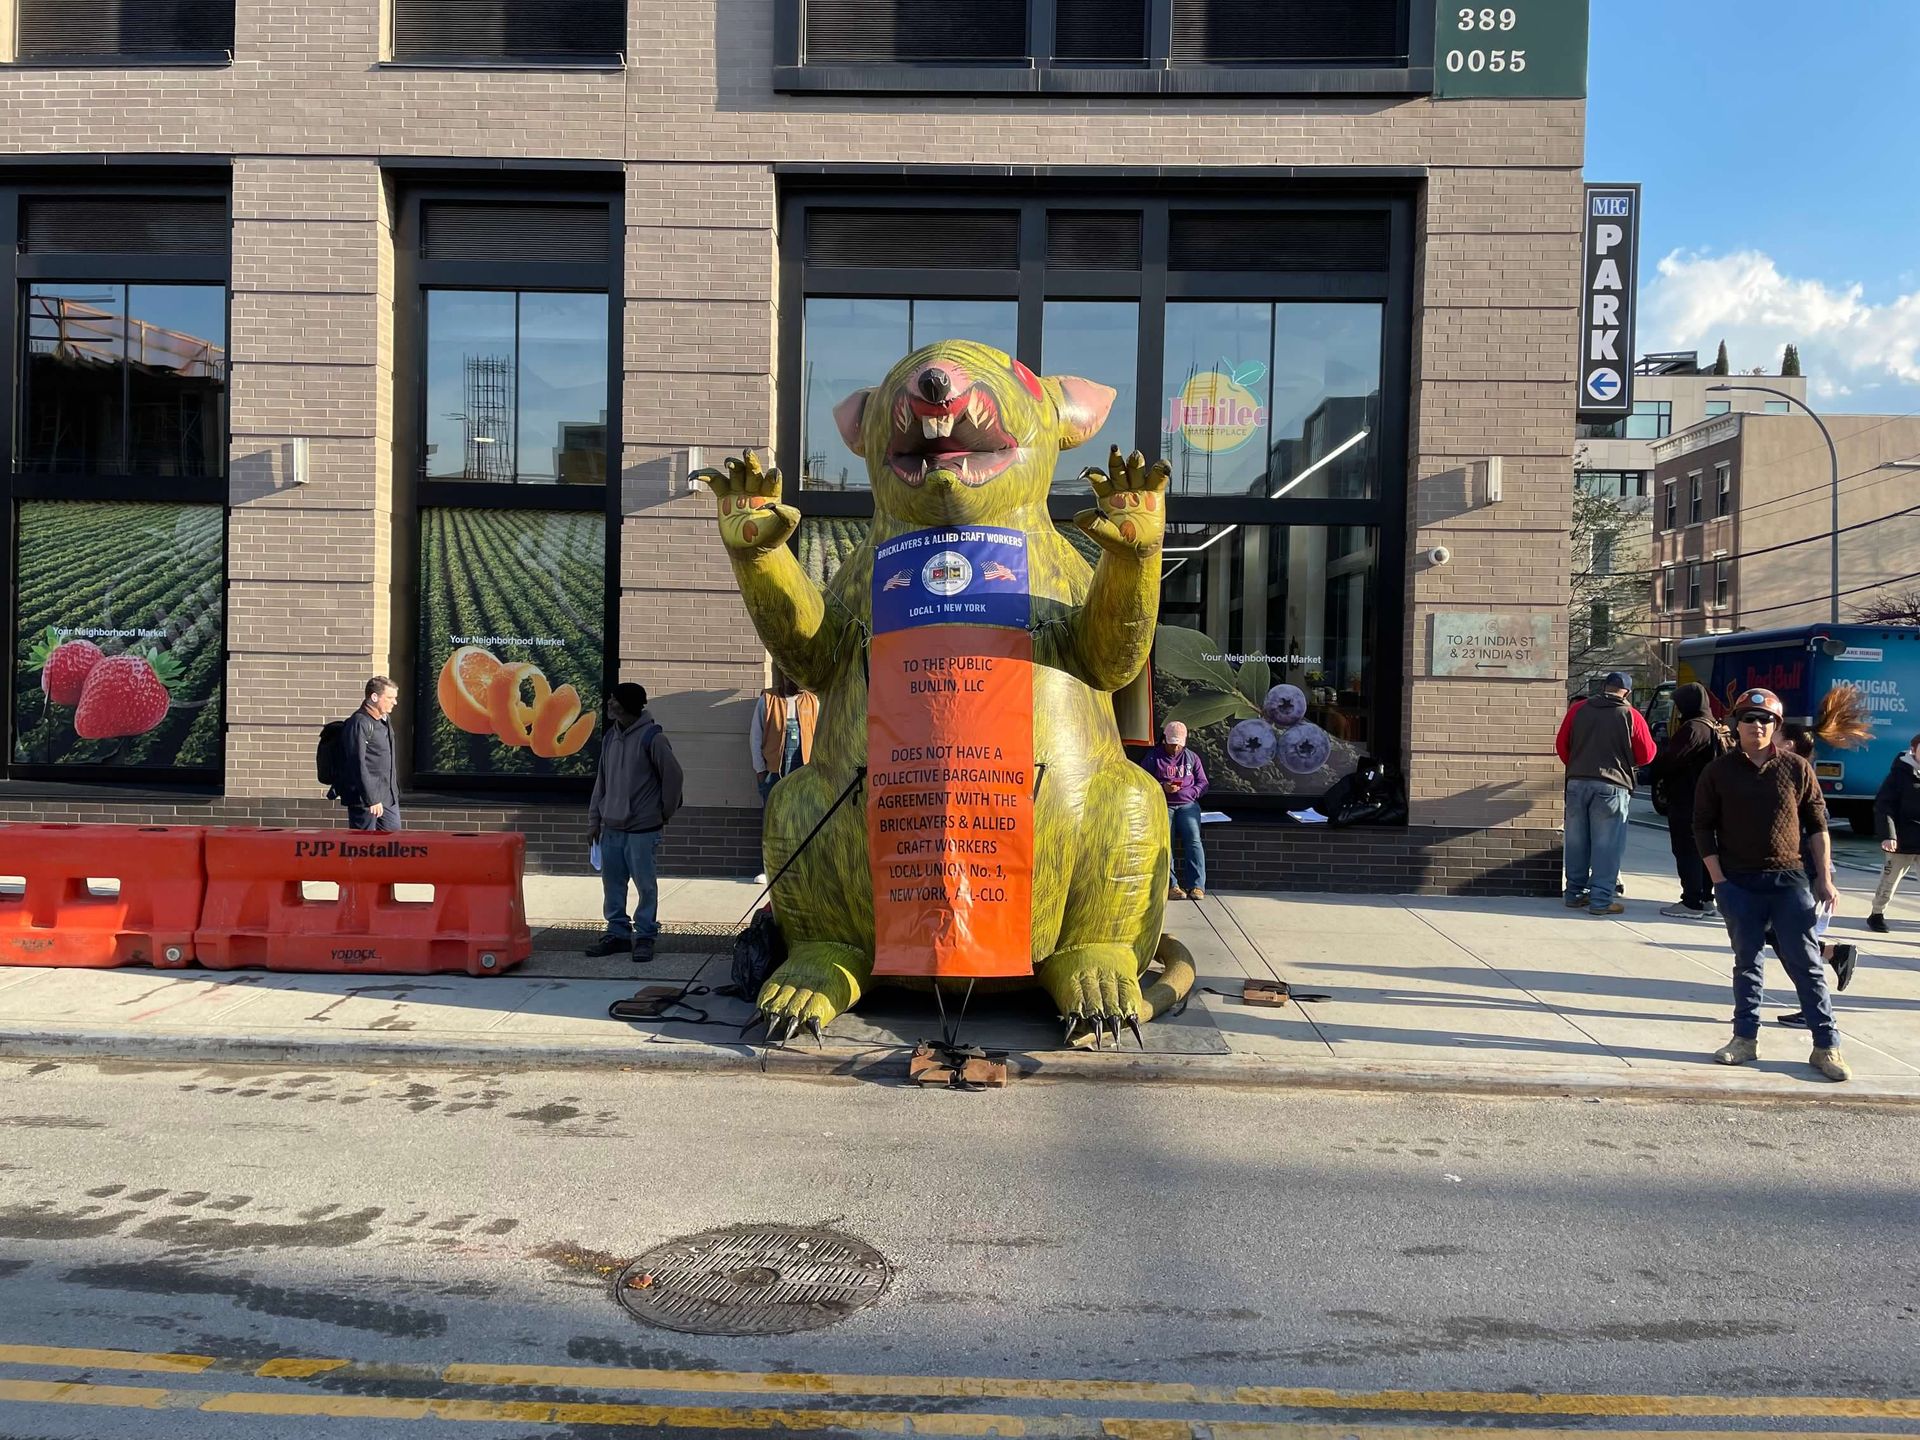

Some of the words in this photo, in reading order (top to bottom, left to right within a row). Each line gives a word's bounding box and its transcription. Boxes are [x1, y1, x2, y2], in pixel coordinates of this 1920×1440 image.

[1457, 8, 1517, 31] 389
[1445, 49, 1527, 73] 0055
[1590, 224, 1624, 361] PARK
[1161, 397, 1268, 434] Jubilee
[1187, 428, 1248, 436] MARKETPLACE
[877, 538, 923, 559] BRICKLAYERS
[924, 536, 930, 546] &
[932, 532, 959, 544] ALLIED
[960, 531, 985, 542] CRAFT
[987, 534, 1023, 548] WORKERS
[909, 605, 934, 617] LOCAL
[937, 604, 941, 613] 1
[943, 603, 963, 613] NEW
[964, 603, 986, 613] YORK
[53, 627, 73, 637] Your
[75, 627, 135, 638] Neighborhood
[138, 629, 167, 638] Market
[450, 635, 469, 644] Your
[472, 635, 533, 646] Neighborhood
[535, 637, 565, 647] Market
[1447, 635, 1463, 645] TO
[1466, 635, 1479, 646] 21
[1484, 635, 1517, 647] INDIA
[1520, 636, 1538, 647] ST.
[1201, 652, 1222, 662] Your
[1224, 653, 1288, 664] Neighborhood
[1291, 654, 1321, 664] Market
[1450, 649, 1458, 658] &
[1461, 649, 1476, 659] 23
[1479, 649, 1513, 660] INDIA
[1515, 650, 1533, 660] ST.
[903, 659, 919, 673] TO
[922, 658, 945, 671] THE
[949, 657, 993, 671] PUBLIC
[1747, 666, 1772, 689] Red
[1775, 662, 1800, 690] Bull
[910, 679, 960, 694] BUNLIN,
[964, 679, 985, 692] LLC
[1854, 679, 1900, 696] SUGAR,
[891, 747, 923, 762] DOES
[926, 746, 953, 759] NOT
[956, 746, 990, 760] HAVE
[993, 747, 1003, 760] A
[872, 769, 940, 787] COLLECTIVE
[943, 769, 1025, 785] BARGAINING
[877, 791, 952, 809] AGREEMENT
[955, 792, 990, 806] WITH
[993, 793, 1017, 807] THE
[880, 815, 955, 833] BRICKLAYERS
[958, 815, 969, 829] &
[972, 816, 1016, 831] ALLIED
[294, 841, 335, 857] PJP
[339, 842, 428, 858] Installers
[896, 839, 932, 855] CRAFT
[935, 838, 997, 854] WORKERS
[889, 864, 923, 879] LOCAL
[970, 864, 991, 878] No.
[995, 864, 1007, 879] 1,
[889, 888, 914, 903] NEW
[916, 887, 951, 903] YORK,
[954, 887, 1008, 902] AL-CLO.
[331, 949, 377, 960] YODOCK
